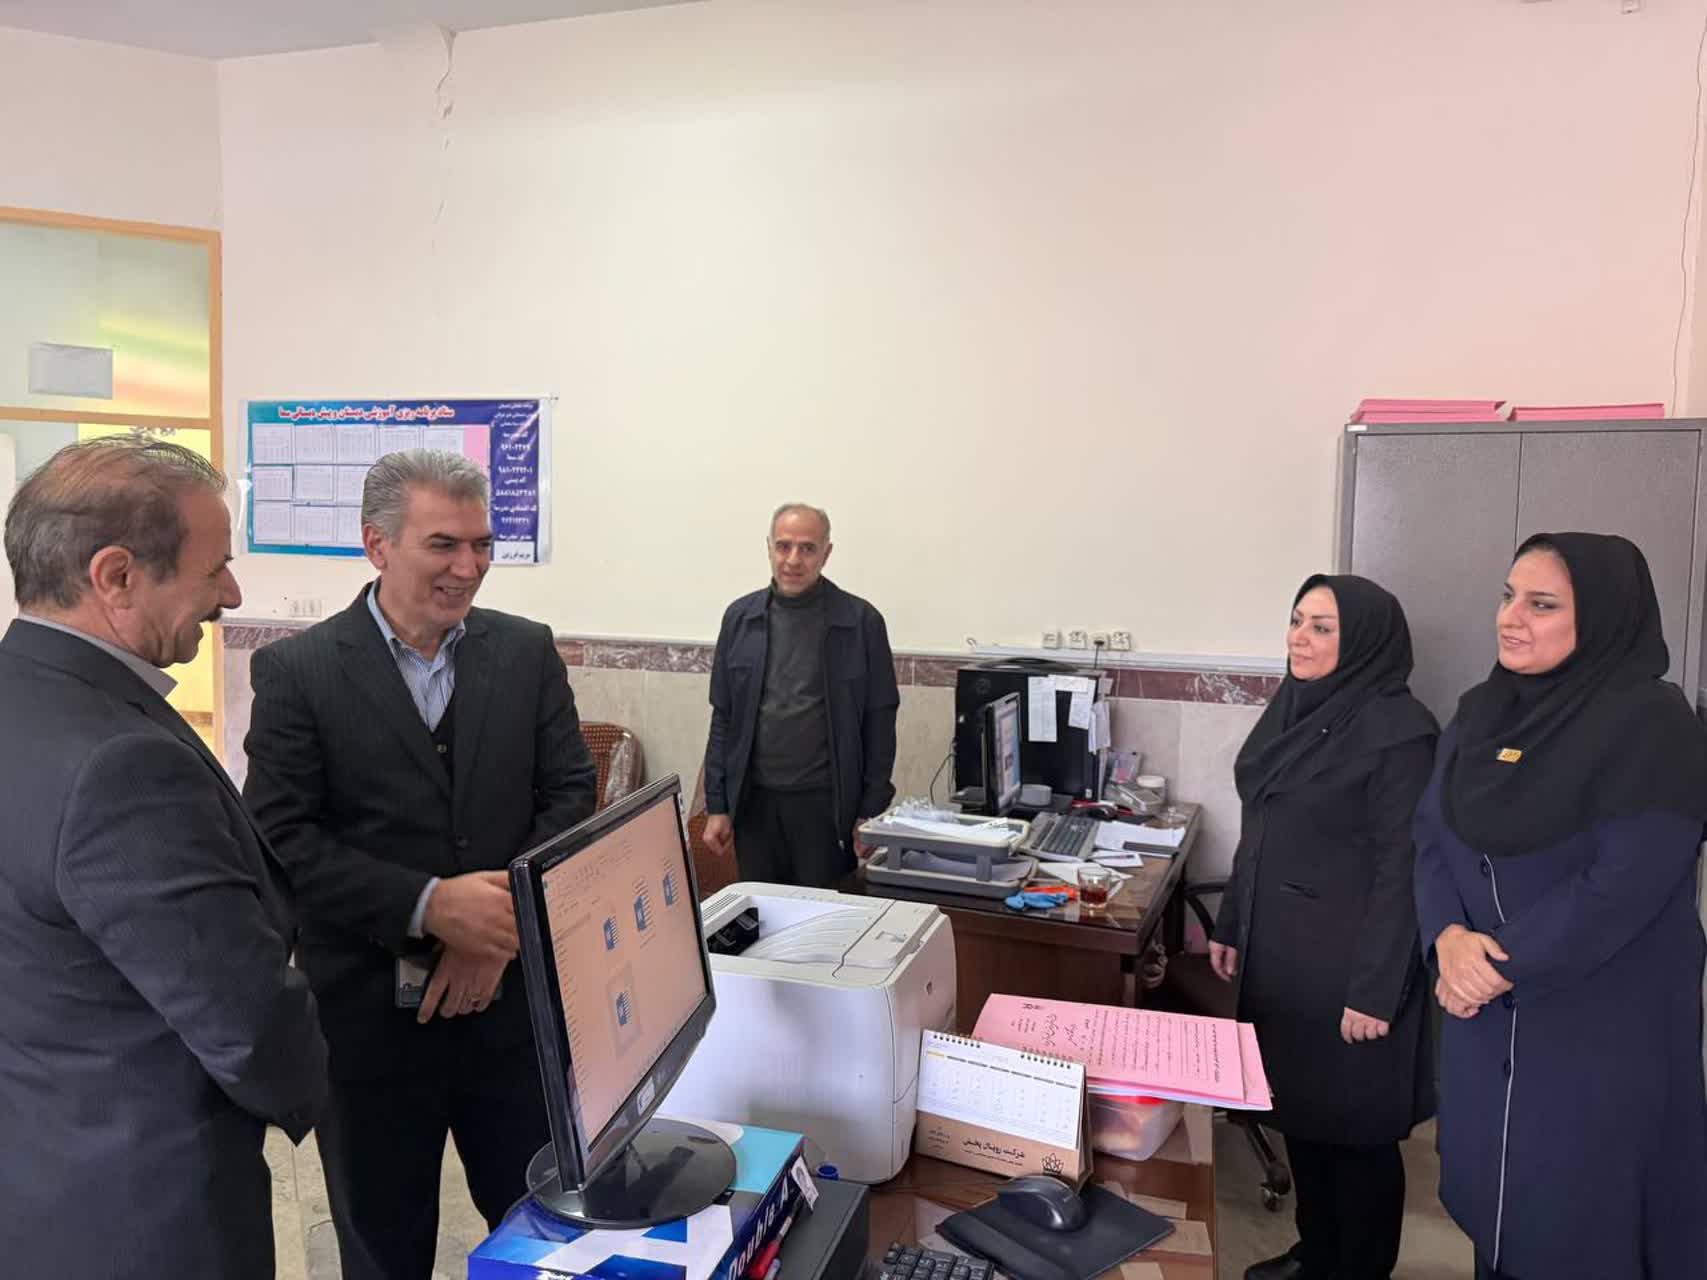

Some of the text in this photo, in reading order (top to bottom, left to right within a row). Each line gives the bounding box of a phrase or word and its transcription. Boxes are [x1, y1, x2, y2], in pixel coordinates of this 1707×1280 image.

[292, 405, 316, 421] دبستانی
[339, 405, 364, 420] دبستان
[364, 404, 396, 420] آموزشی
[1003, 1148, 1025, 1160] شرکت
